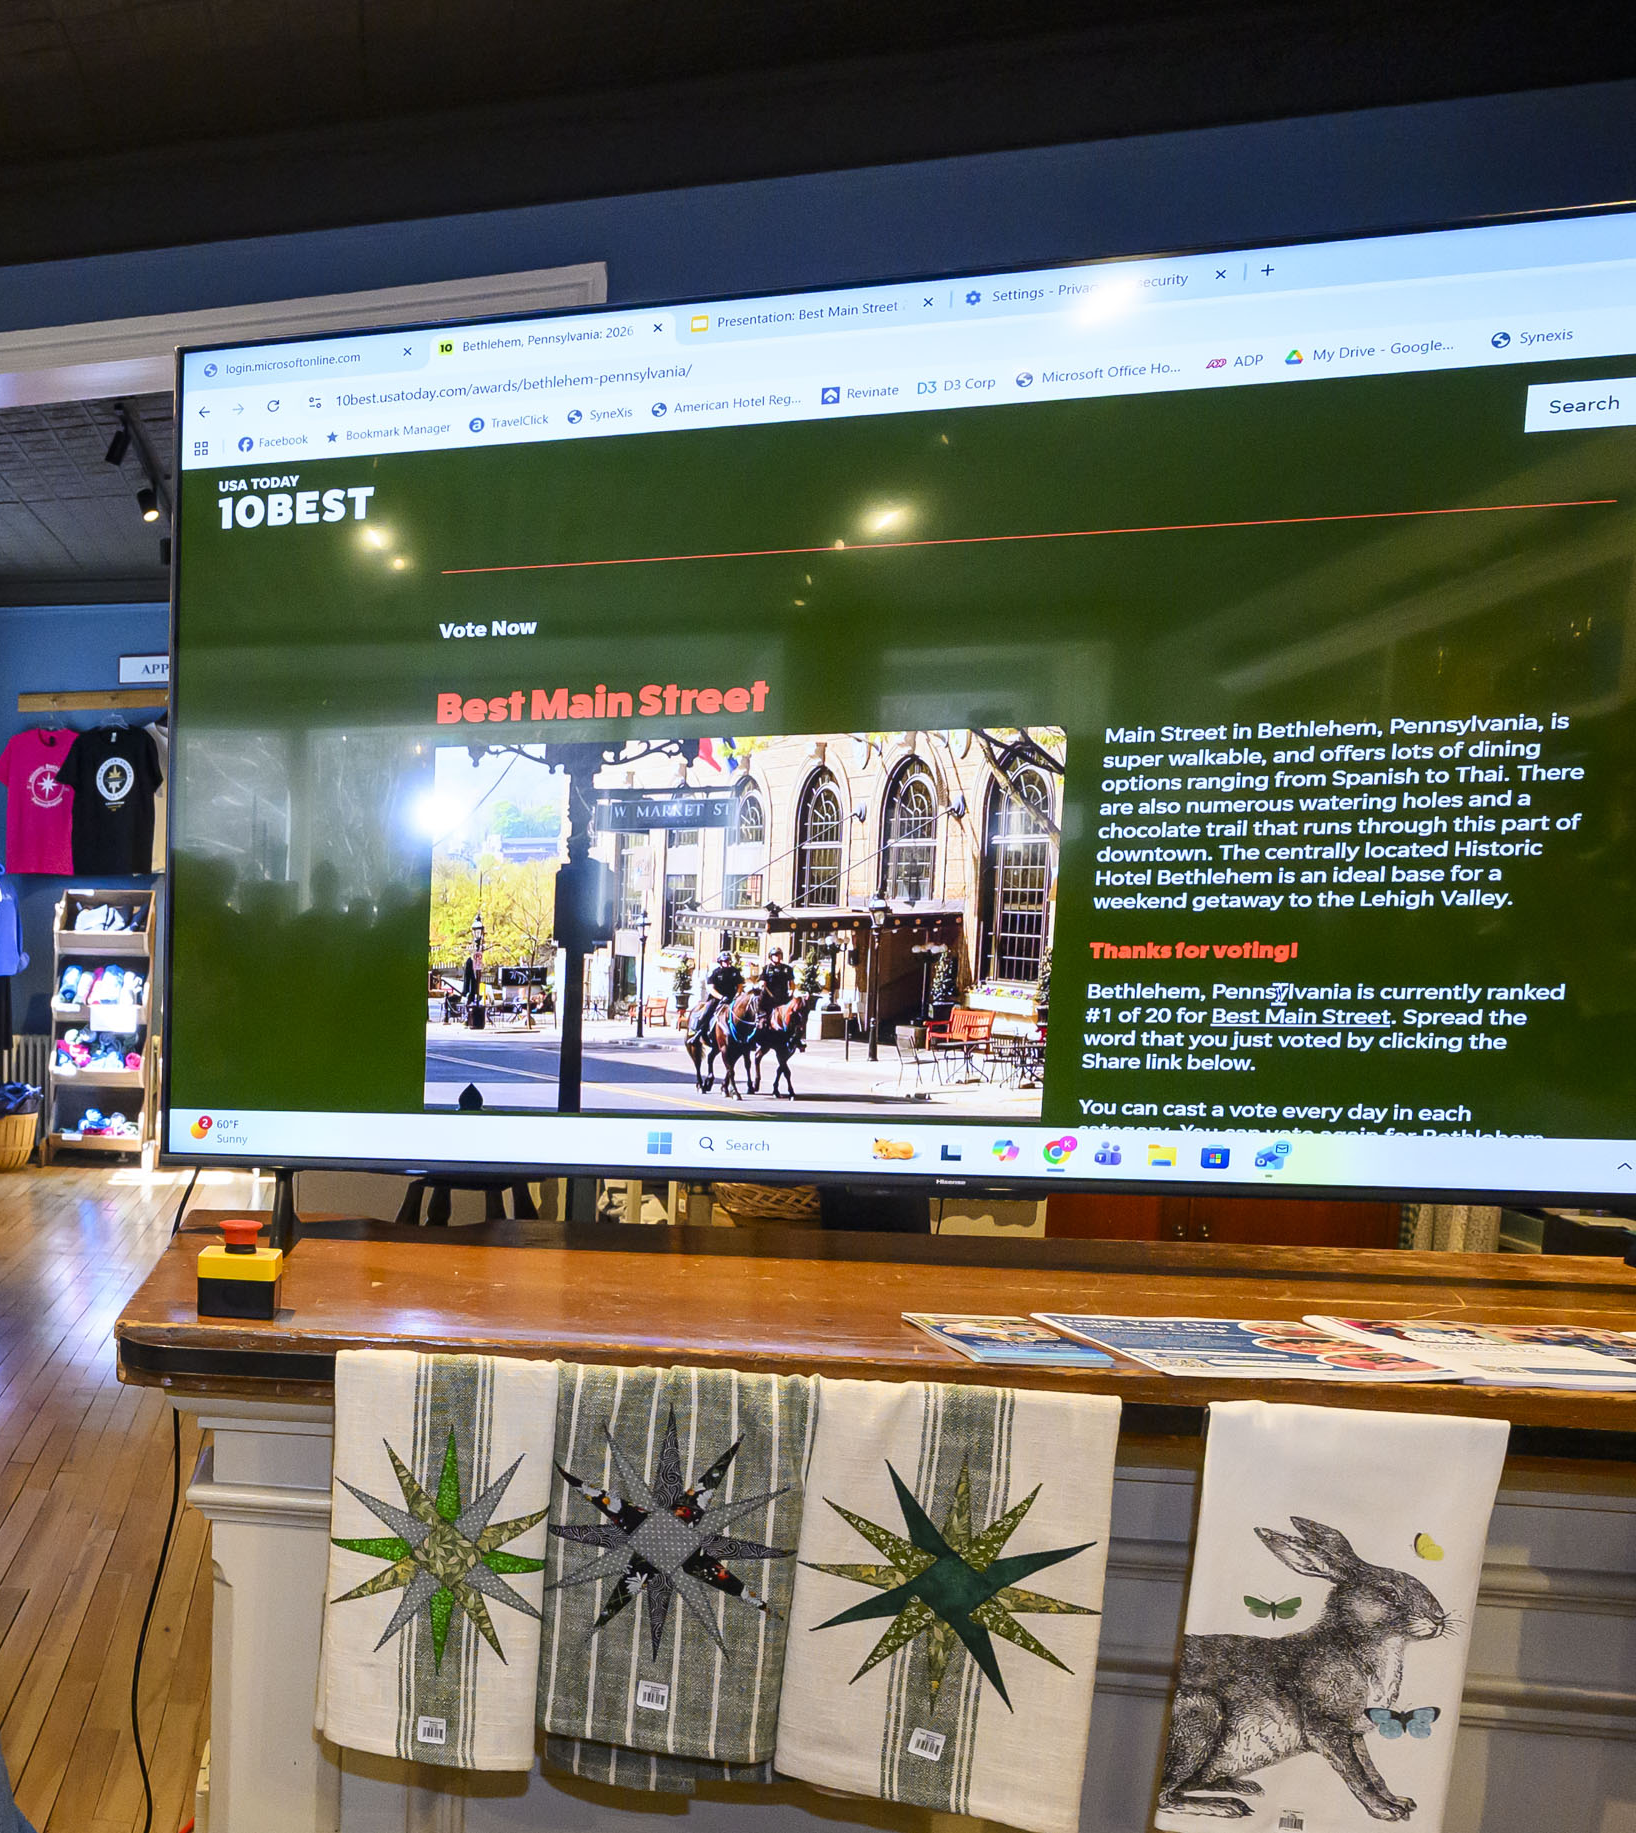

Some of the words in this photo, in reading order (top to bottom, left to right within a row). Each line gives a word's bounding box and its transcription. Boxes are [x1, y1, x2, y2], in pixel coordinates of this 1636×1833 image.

[993, 288, 1043, 301] Settings
[1058, 281, 1101, 296] Privac
[718, 313, 794, 327] Presentation:
[800, 309, 823, 319] Best
[829, 307, 858, 317] Main
[863, 302, 897, 313] Street
[441, 344, 452, 352] 10
[463, 339, 523, 351] Bethlehem,
[528, 332, 602, 344] Pennsylvania:
[606, 327, 634, 338] 2026
[1520, 331, 1572, 345] Synexis
[1234, 355, 1263, 367] ADP
[1314, 349, 1334, 362] My
[1340, 347, 1375, 358] Drive
[1391, 340, 1453, 354] Google...
[226, 355, 360, 375] login.microsoftonline.com
[1043, 368, 1103, 382] Microsoft
[1108, 366, 1146, 377] Office
[1151, 363, 1180, 373] Ho...
[337, 364, 693, 412] 10best.usatoday.com/awards/bethlehem-pennsylvania/
[848, 387, 898, 398] Revinate
[918, 381, 936, 394] D3
[944, 380, 960, 391] D3
[966, 379, 995, 389] Corp
[675, 402, 728, 412] American
[734, 396, 764, 408] Hotel
[769, 395, 801, 406] Reg...
[1550, 396, 1619, 413] Search
[492, 415, 548, 427] TravelClick
[591, 408, 632, 421] SyneXis
[260, 435, 308, 447] Facebook
[347, 427, 399, 440] Bookmark
[404, 425, 449, 435] Manager
[219, 479, 247, 492] USA
[251, 475, 299, 489] TODAY
[219, 486, 374, 529] 10BEST
[439, 623, 487, 638] Vote
[492, 621, 537, 636] Now
[437, 690, 525, 724] Best
[531, 684, 633, 720] Main
[639, 680, 770, 716] Street
[1106, 727, 1155, 743] Main
[1161, 725, 1227, 741] Street
[1233, 723, 1251, 739] in
[1258, 720, 1382, 738] Bethlehem,
[1390, 714, 1543, 735] Pennsylvania,
[1552, 713, 1569, 729] is
[1103, 755, 1164, 770] super
[1168, 748, 1266, 766] walkable,
[1273, 746, 1314, 763] and
[1320, 745, 1385, 761] offers
[1392, 744, 1433, 759] lots
[1439, 742, 1464, 758] of
[1469, 740, 1540, 759] dining
[1102, 775, 1181, 794] options
[1187, 772, 1268, 792] ranging
[1275, 771, 1326, 787] from
[1332, 768, 1419, 789] Spanish
[1425, 769, 1449, 783] to
[1455, 765, 1509, 782] Thai.
[1517, 764, 1584, 781] There
[614, 808, 626, 818] W
[636, 803, 704, 818] MARKET
[1100, 803, 1133, 815] are
[1138, 798, 1180, 814] also
[1187, 800, 1293, 813] numerous
[1299, 793, 1396, 812] watering
[1403, 792, 1463, 808] holes
[1469, 790, 1512, 807] and
[1518, 794, 1530, 806] a
[1098, 822, 1201, 838] chocolate
[1206, 820, 1247, 836] trail
[1253, 820, 1298, 835] that
[1304, 822, 1352, 835] runs
[1357, 816, 1447, 836] through
[1453, 815, 1495, 832] this
[1501, 816, 1550, 834] part
[1556, 813, 1582, 830] of
[1097, 846, 1212, 862] downtown.
[1219, 844, 1260, 860] The
[1265, 842, 1360, 861] centrally
[1365, 841, 1448, 858] located
[1455, 839, 1543, 856] Historic
[1096, 869, 1151, 885] Hotel
[1158, 868, 1272, 885] Bethlehem
[1279, 868, 1295, 883] is
[1301, 871, 1326, 883] an
[1333, 866, 1385, 882] ideal
[1392, 866, 1444, 882] base
[1450, 865, 1484, 881] for
[1488, 869, 1501, 880] a
[1094, 893, 1187, 909] weekend
[1192, 894, 1284, 911] getaway
[1289, 893, 1312, 907] to
[1317, 891, 1354, 907] the
[1361, 890, 1434, 909] Lehigh
[1441, 889, 1512, 909] Valley.
[1090, 942, 1172, 959] Thanks
[1175, 942, 1210, 959] for
[1212, 941, 1298, 962] voting!
[1088, 983, 1205, 1001] Bethlehem,
[1213, 983, 1351, 1006] Pennsylvania
[1358, 983, 1374, 999] is
[1380, 984, 1482, 1003] currently
[1487, 984, 1565, 1000] ranked
[1086, 1008, 1110, 1022] #1
[1119, 1007, 1141, 1023] of
[1145, 1008, 1171, 1023] 20
[1176, 1007, 1207, 1023] for
[1210, 1008, 1263, 1027] Best
[1263, 1008, 1320, 1027] Main
[1319, 1009, 1396, 1027] Street.
[1403, 1009, 1483, 1028] Spread
[1489, 1009, 1527, 1025] the
[1084, 1030, 1135, 1046] word
[1141, 1031, 1184, 1046] that
[1188, 1035, 1227, 1050] you
[1230, 1031, 1273, 1050] just
[1278, 1032, 1341, 1048] voted
[1348, 1032, 1374, 1051] by
[1379, 1032, 1462, 1052] clicking
[1469, 1033, 1507, 1049] the
[1082, 1053, 1140, 1069] Share
[1146, 1054, 1182, 1069] link
[1187, 1054, 1255, 1070] below.
[1079, 1100, 1116, 1114] You
[1122, 1104, 1157, 1115] can
[1163, 1103, 1207, 1116] cast
[1212, 1105, 1224, 1117] a
[1230, 1104, 1277, 1117] vote
[1283, 1107, 1343, 1122] every
[1348, 1104, 1388, 1123] day
[1394, 1104, 1412, 1120] in
[1418, 1105, 1471, 1121] each
[202, 1118, 209, 1128] 2
[217, 1120, 238, 1128] 60°F
[217, 1134, 247, 1145] Sunny
[727, 1140, 769, 1151] Search
